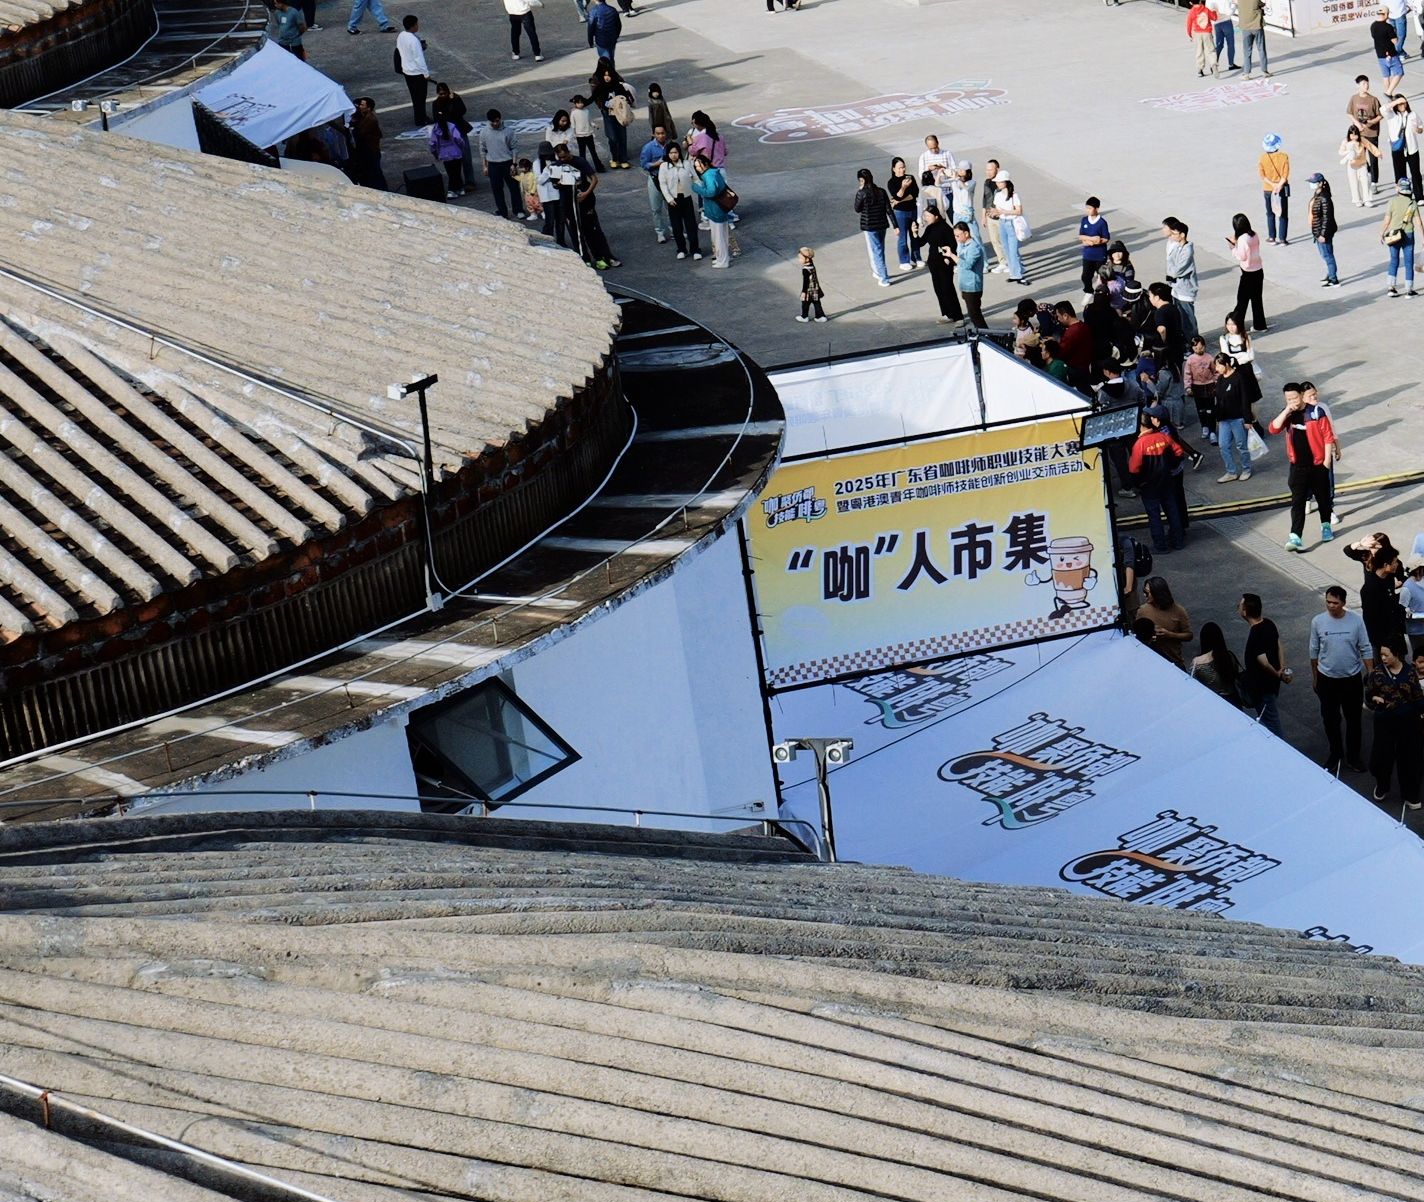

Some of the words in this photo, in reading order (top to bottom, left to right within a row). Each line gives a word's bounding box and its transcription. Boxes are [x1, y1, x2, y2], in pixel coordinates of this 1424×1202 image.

[835, 441, 1080, 495] 2025年广东省咖啡师职业技能大赛
[837, 460, 1083, 513] 暨粤港澳青年咖啡师技能创新创业交流活动
[788, 513, 1050, 602] “咖”人市集
